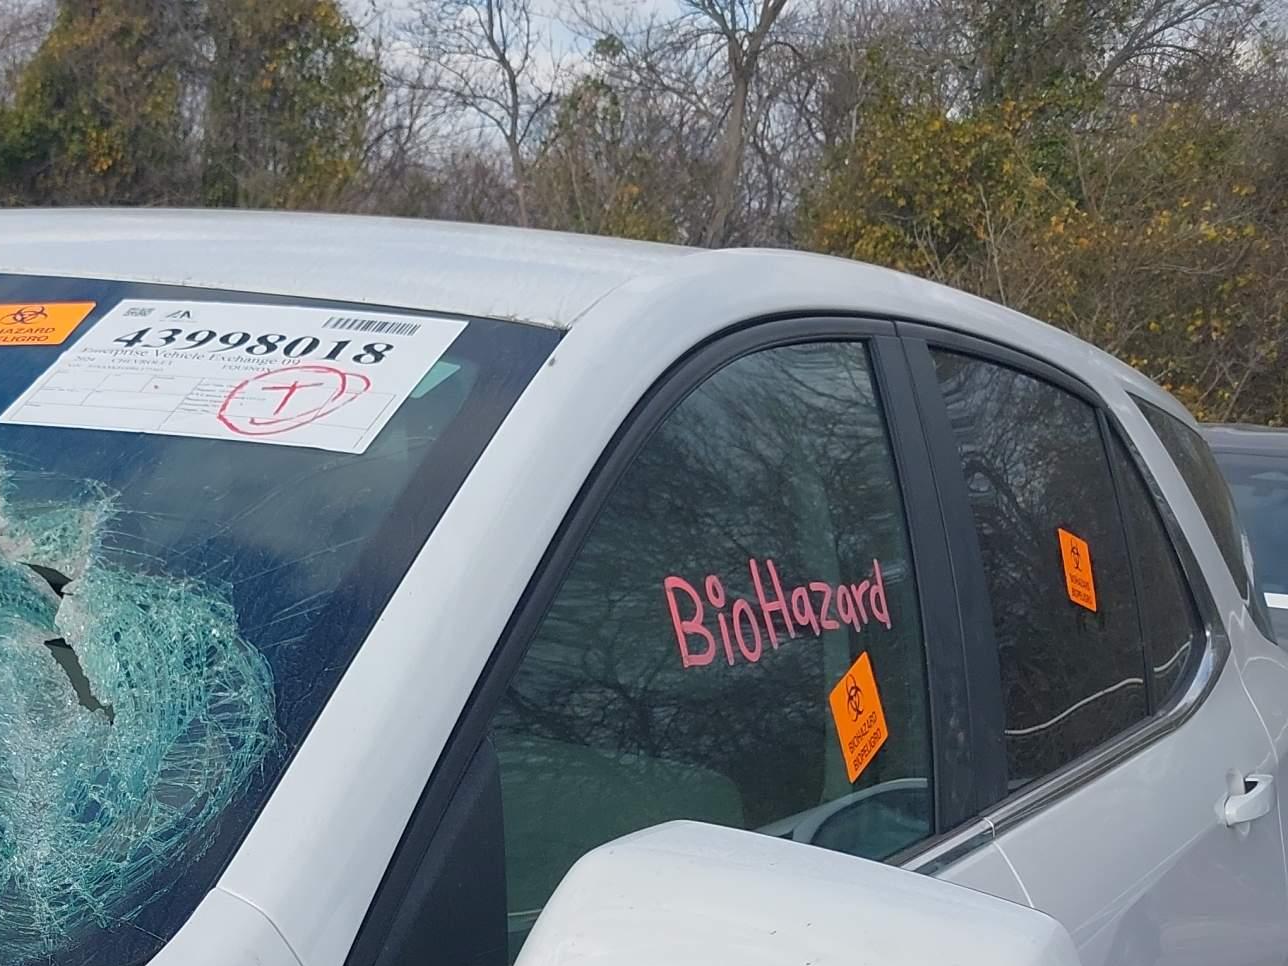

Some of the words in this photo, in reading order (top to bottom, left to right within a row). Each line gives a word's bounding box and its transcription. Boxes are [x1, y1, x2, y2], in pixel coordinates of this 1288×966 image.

[112, 326, 395, 365] 43998018
[154, 348, 205, 361] Vehicle
[208, 351, 279, 367] Exchange
[663, 558, 892, 668] BioHazard
[848, 711, 878, 754] BIOHAZARD
[853, 728, 882, 772] BIOPELIGRO
